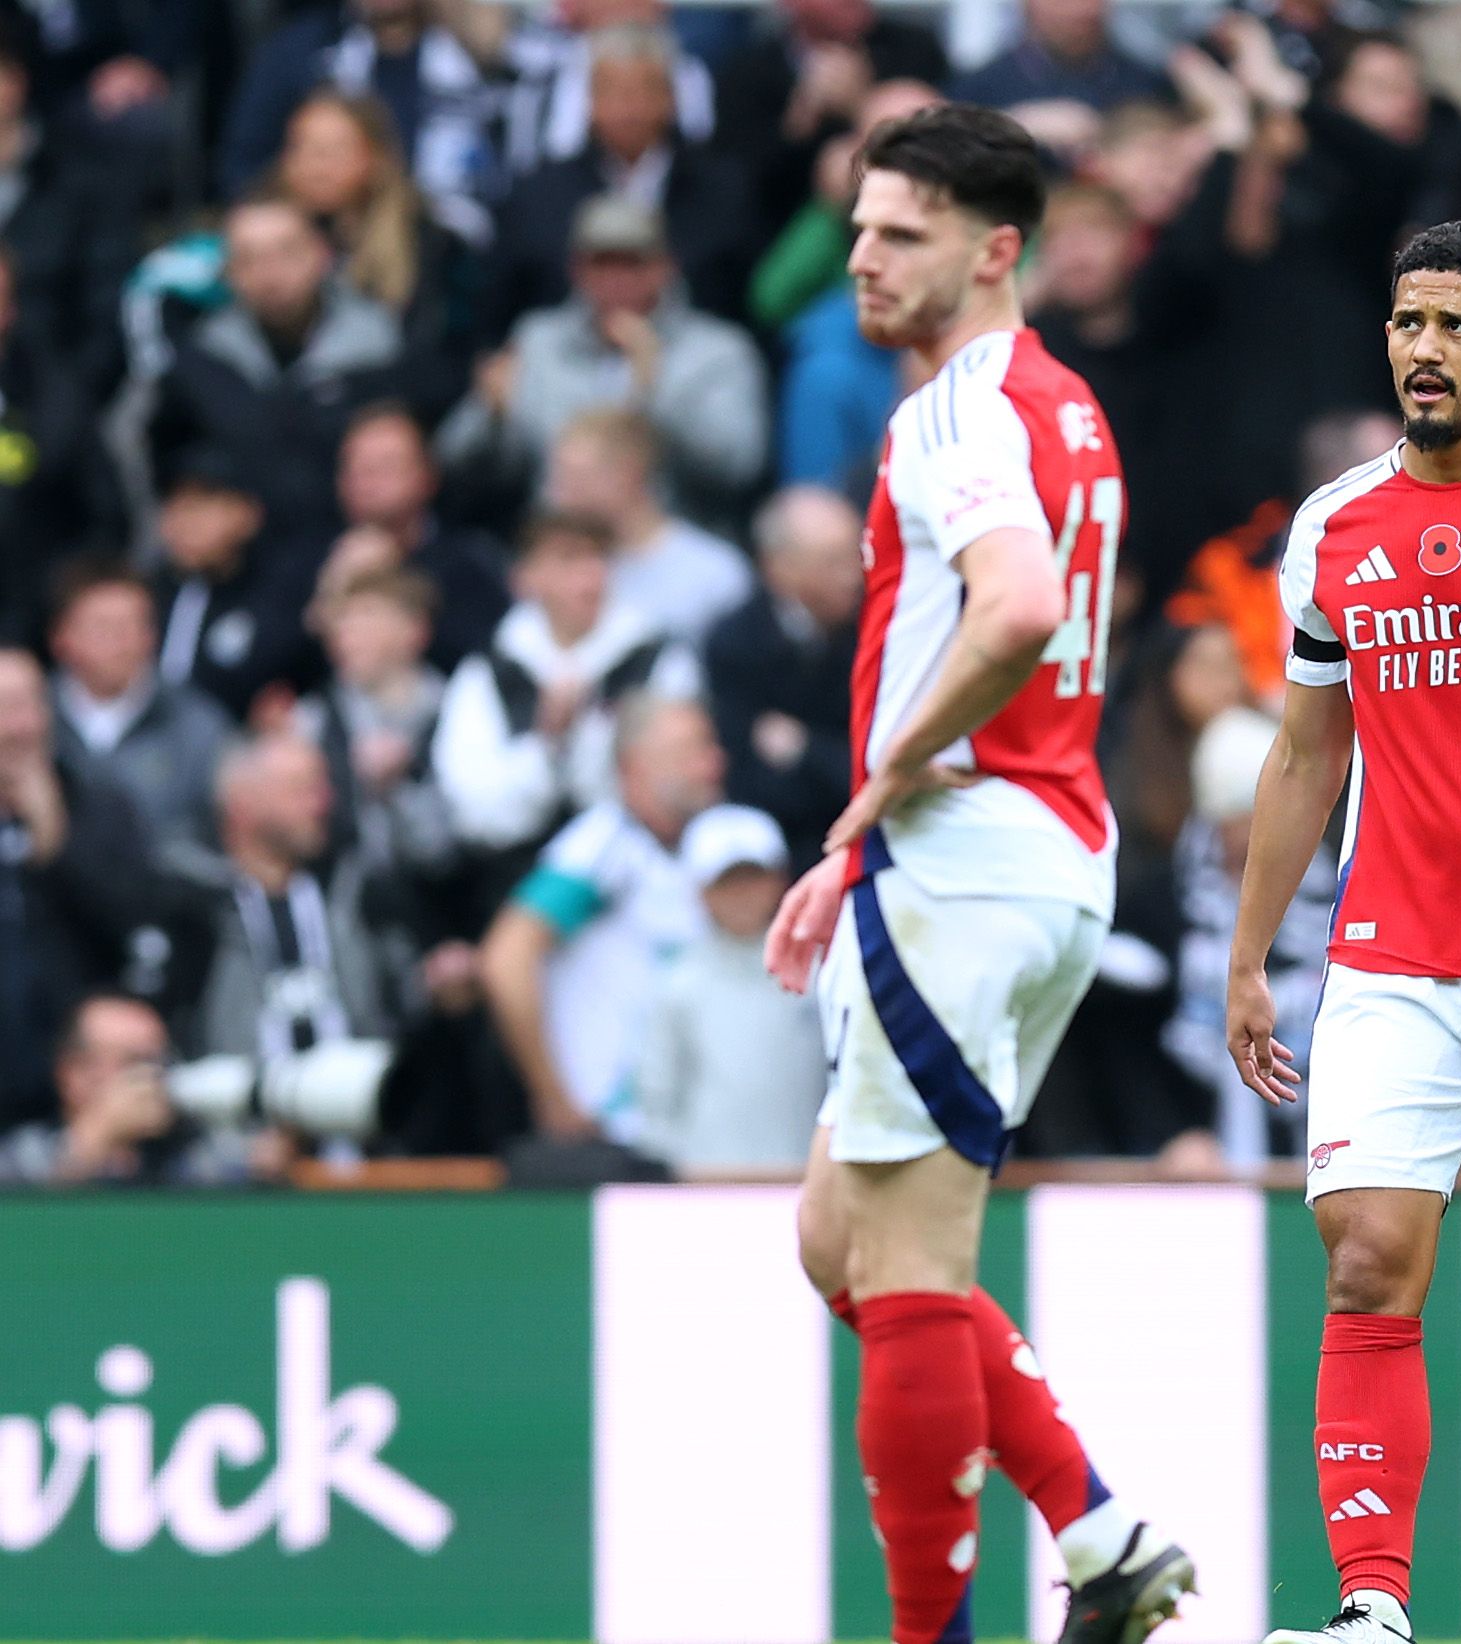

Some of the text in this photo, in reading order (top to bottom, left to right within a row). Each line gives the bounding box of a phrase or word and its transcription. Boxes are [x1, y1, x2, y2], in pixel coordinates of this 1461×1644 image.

[1040, 476, 1123, 698] 41
[1379, 651, 1419, 692] FLY
[1320, 1443, 1384, 1461] AFC
